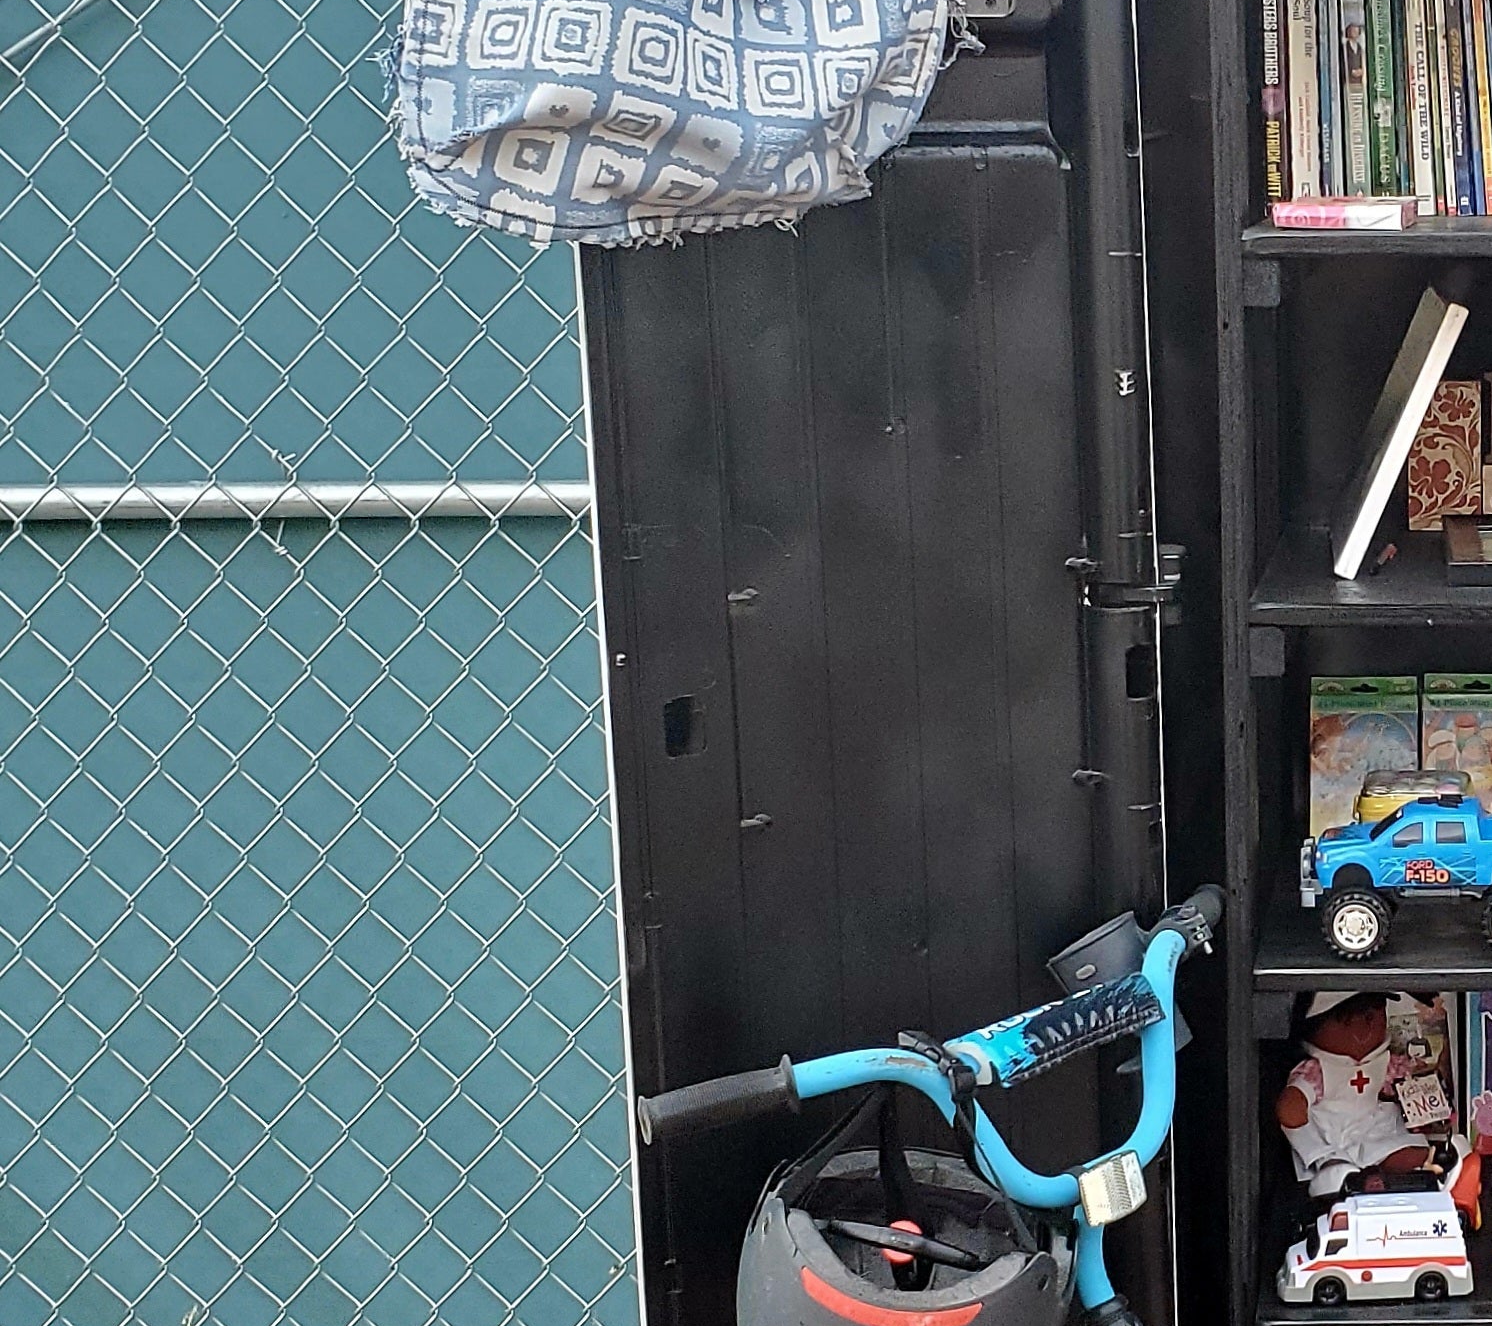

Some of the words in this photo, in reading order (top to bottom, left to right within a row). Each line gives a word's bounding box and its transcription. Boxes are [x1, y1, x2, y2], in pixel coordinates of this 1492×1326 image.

[1292, 0, 1303, 21] Soul
[1304, 25, 1313, 40] for
[1415, 23, 1424, 48] THE
[1264, 32, 1280, 85] BROTHERS
[1304, 42, 1314, 58] the
[1416, 51, 1425, 82] CALL
[1417, 85, 1426, 99] OF
[1418, 102, 1428, 126] THE
[1265, 120, 1280, 162] PATRICK
[1420, 130, 1430, 160] WILD
[1406, 860, 1433, 870] FORD
[1406, 869, 1450, 883] F-150
